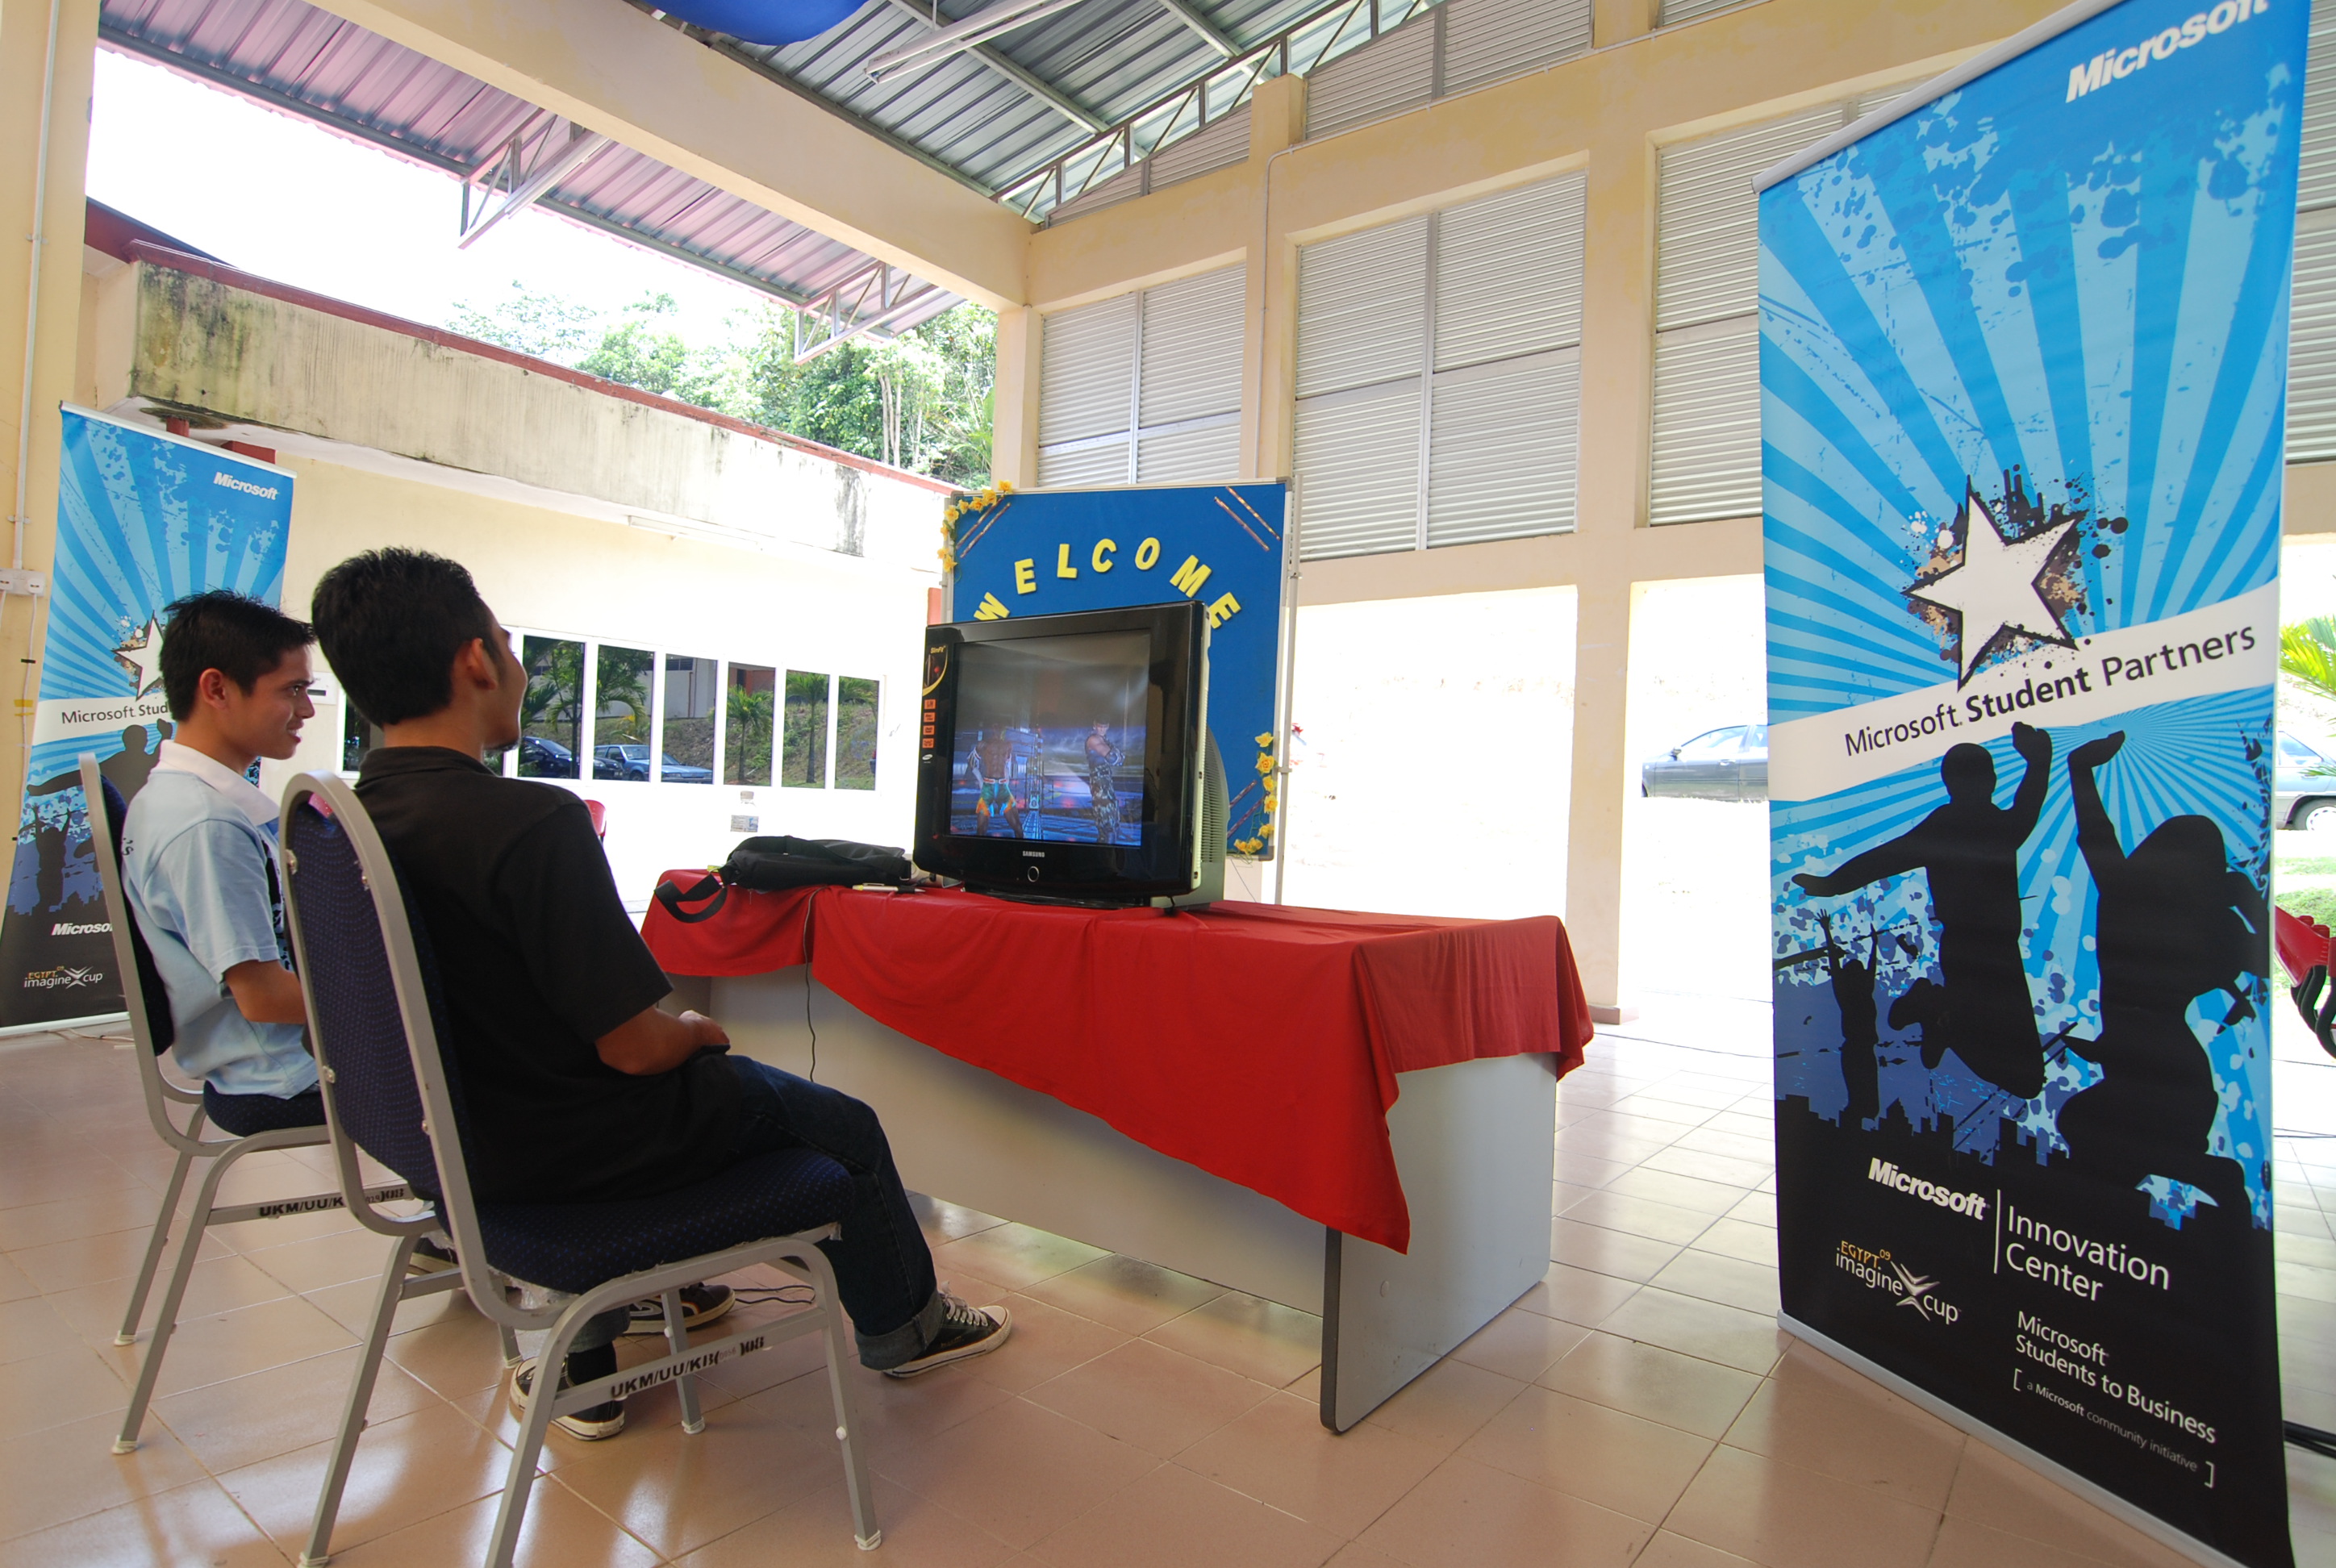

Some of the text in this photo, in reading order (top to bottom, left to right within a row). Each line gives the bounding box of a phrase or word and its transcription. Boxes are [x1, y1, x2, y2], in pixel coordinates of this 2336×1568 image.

[213, 471, 278, 500] Microsoft
[974, 537, 1242, 629] WELCOME
[61, 702, 169, 724] Microsoft Stud
[1845, 626, 2255, 757] Microsoft Student Partners
[52, 923, 113, 936] Microso
[23, 973, 103, 989] imagine cup
[1868, 1157, 1986, 1220] Microsoft
[2006, 1243, 2104, 1301] Center
[2009, 1205, 2170, 1291] Innovation
[1835, 1247, 1958, 1325] imagine cup
[2017, 1311, 2107, 1367] Microsoft
[2016, 1334, 2217, 1444] Students to Business
[2026, 1381, 2198, 1472] a Microsoft community initiative
